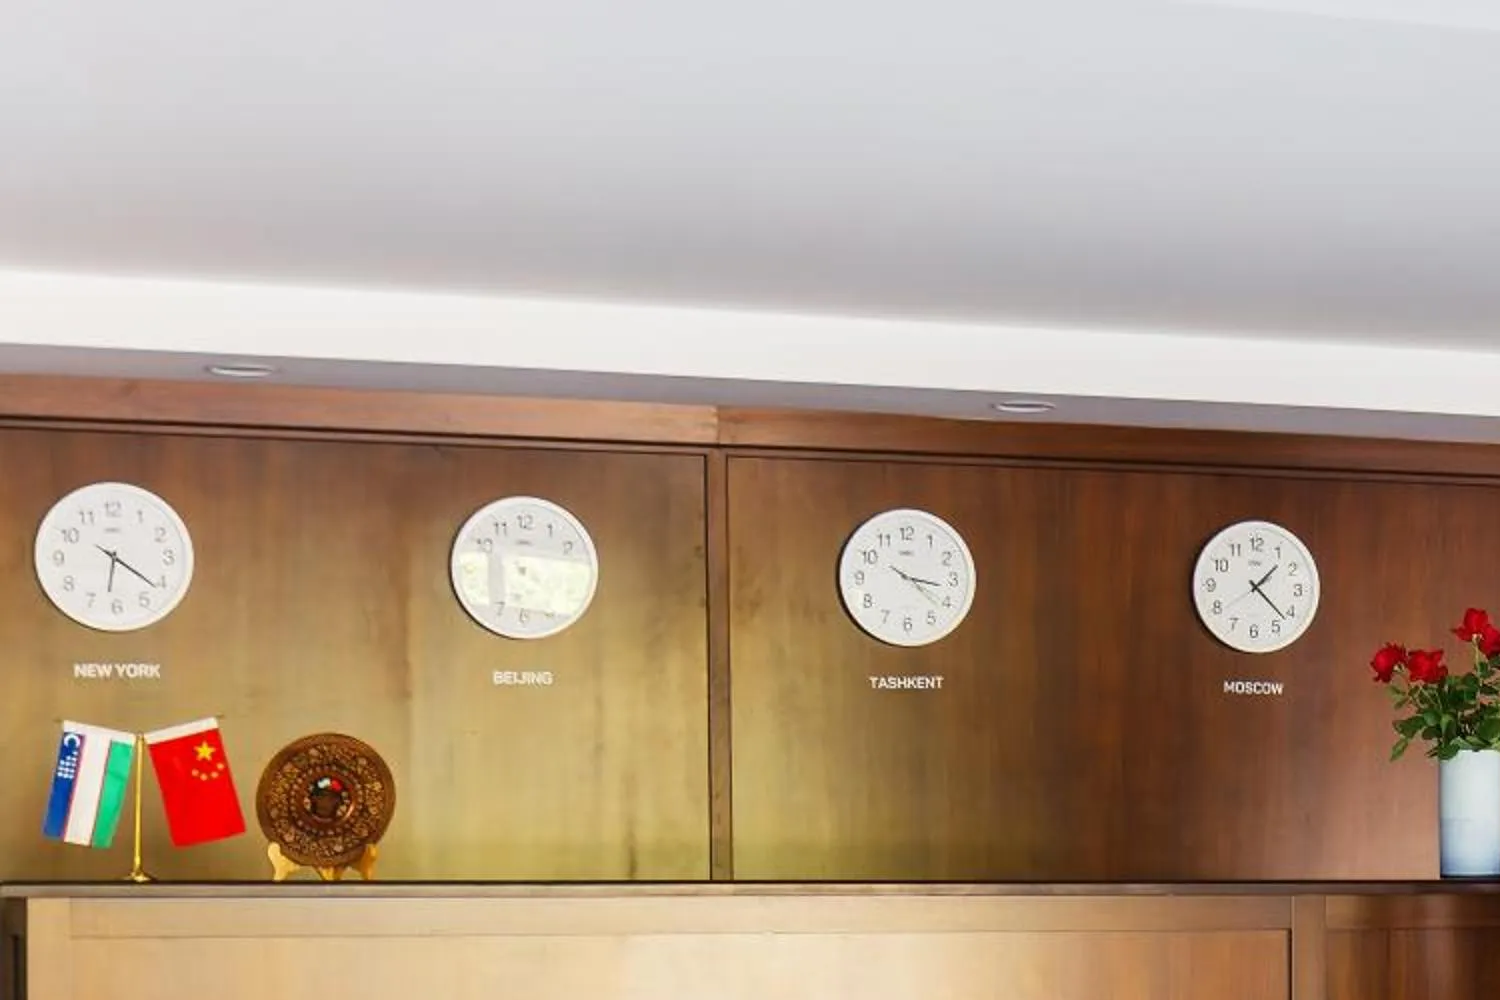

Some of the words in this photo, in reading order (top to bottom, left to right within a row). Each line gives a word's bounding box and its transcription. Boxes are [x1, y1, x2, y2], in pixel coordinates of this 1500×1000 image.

[105, 501, 121, 517] 12
[79, 511, 95, 525] 11
[138, 510, 143, 523] 1
[517, 515, 533, 530] 12
[61, 528, 79, 544] 10
[155, 528, 166, 542] 2
[494, 522, 508, 536] 11
[547, 524, 553, 537] 1
[900, 526, 914, 541] 12
[878, 534, 891, 546] 11
[928, 535, 934, 548] 1
[1250, 538, 1264, 552] 12
[863, 549, 878, 564] 10
[1230, 544, 1241, 556] 11
[1274, 547, 1281, 559] 1
[53, 550, 64, 566] 9
[163, 550, 174, 565] 3
[942, 551, 952, 565] 2
[1215, 560, 1228, 572] 10
[1288, 562, 1297, 576] 2
[64, 576, 75, 591] 8
[156, 575, 166, 589] 4
[855, 571, 864, 585] 9
[950, 572, 958, 587] 3
[1206, 578, 1216, 592] 9
[1294, 584, 1302, 597] 3
[87, 593, 96, 608] 7
[111, 599, 123, 614] 6
[139, 592, 150, 608] 5
[864, 594, 873, 608] 8
[943, 596, 951, 607] 4
[496, 601, 505, 616] 7
[1213, 601, 1222, 614] 8
[1287, 606, 1295, 617] 4
[881, 610, 890, 623] 7
[927, 611, 936, 625] 5
[1230, 617, 1238, 630] 7
[903, 618, 912, 631] 6
[1250, 625, 1258, 638] 6
[1272, 620, 1280, 633] 5
[73, 663, 112, 678] NEW
[115, 663, 161, 678] YORK
[493, 671, 553, 685] BEIJING
[868, 676, 944, 690] TASHKENT
[1223, 681, 1284, 695] MOSCOW
